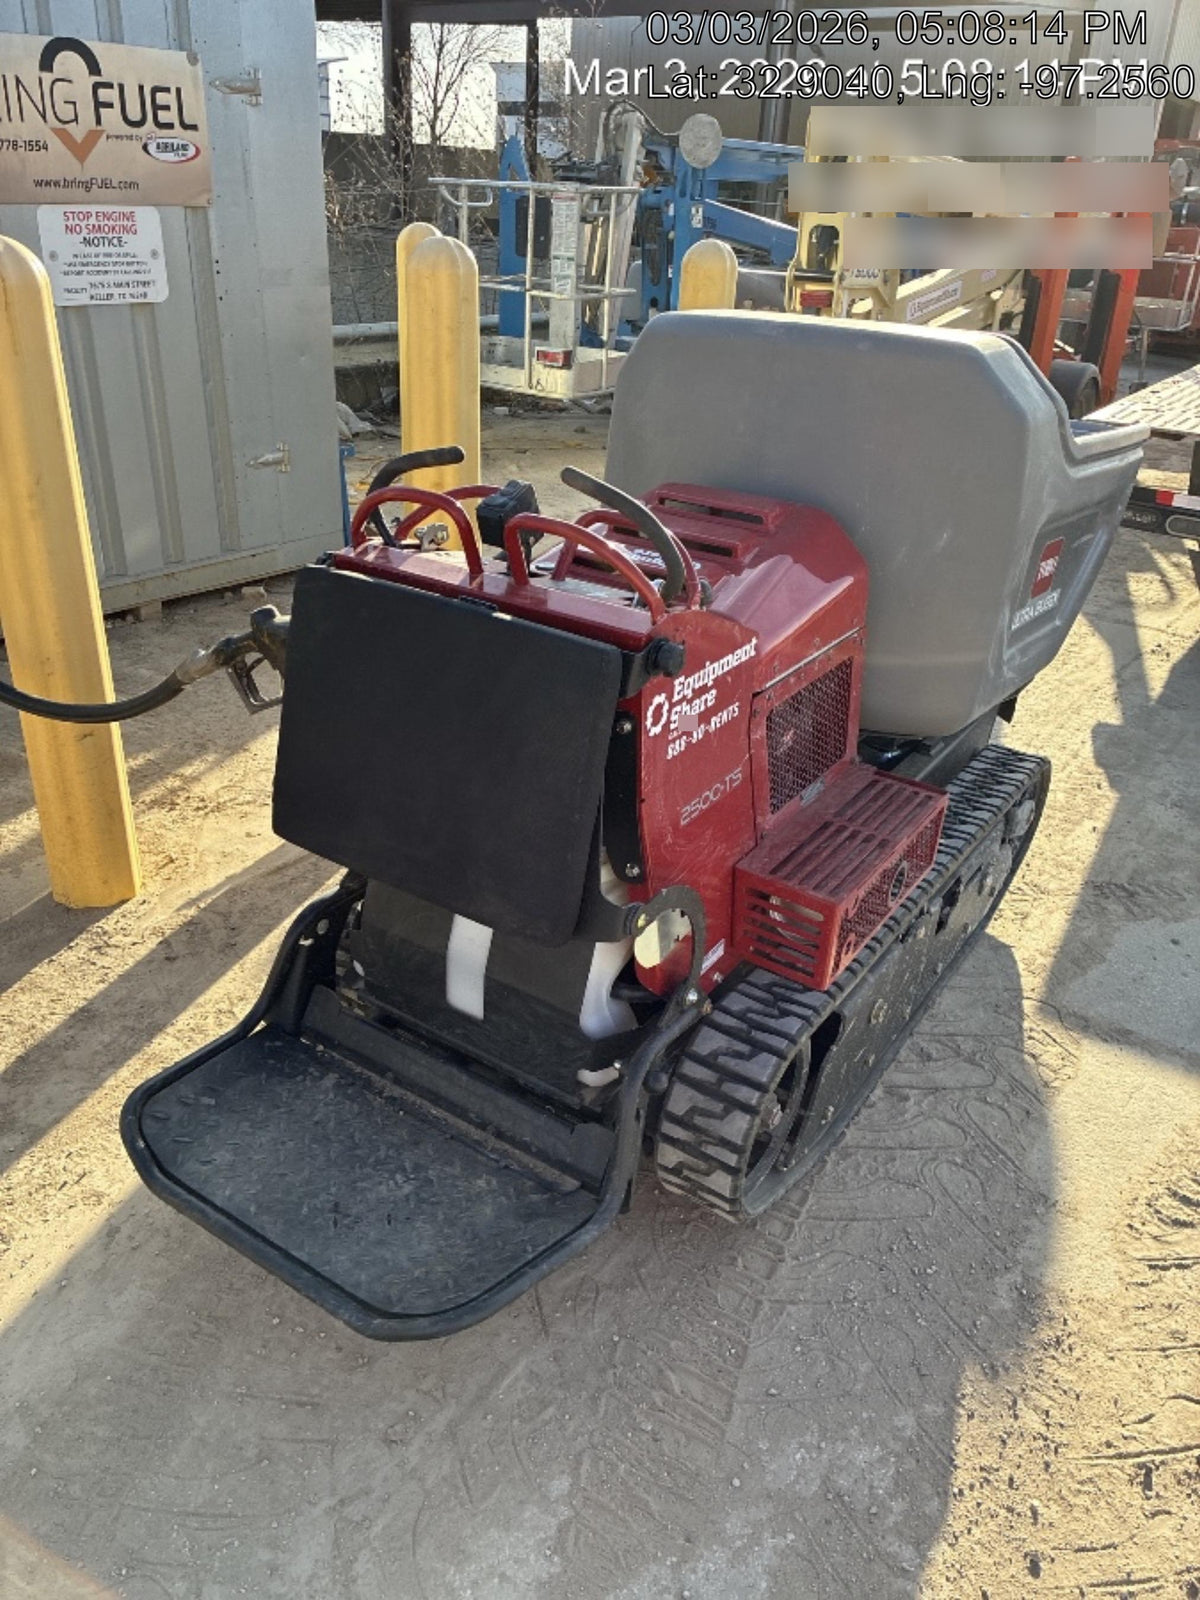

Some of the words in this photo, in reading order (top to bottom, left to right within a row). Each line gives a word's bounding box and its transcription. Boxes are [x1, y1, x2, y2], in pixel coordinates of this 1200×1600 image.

[0, 74, 78, 125] ING
[92, 81, 199, 131] FUEL
[33, 176, 140, 193] www.bringFUEL.com
[63, 211, 93, 222] STOP
[95, 211, 137, 222] ENGINE
[65, 223, 82, 235] NO
[85, 223, 138, 236] SMOKING
[672, 636, 758, 702] Equipment
[670, 689, 717, 729] Share
